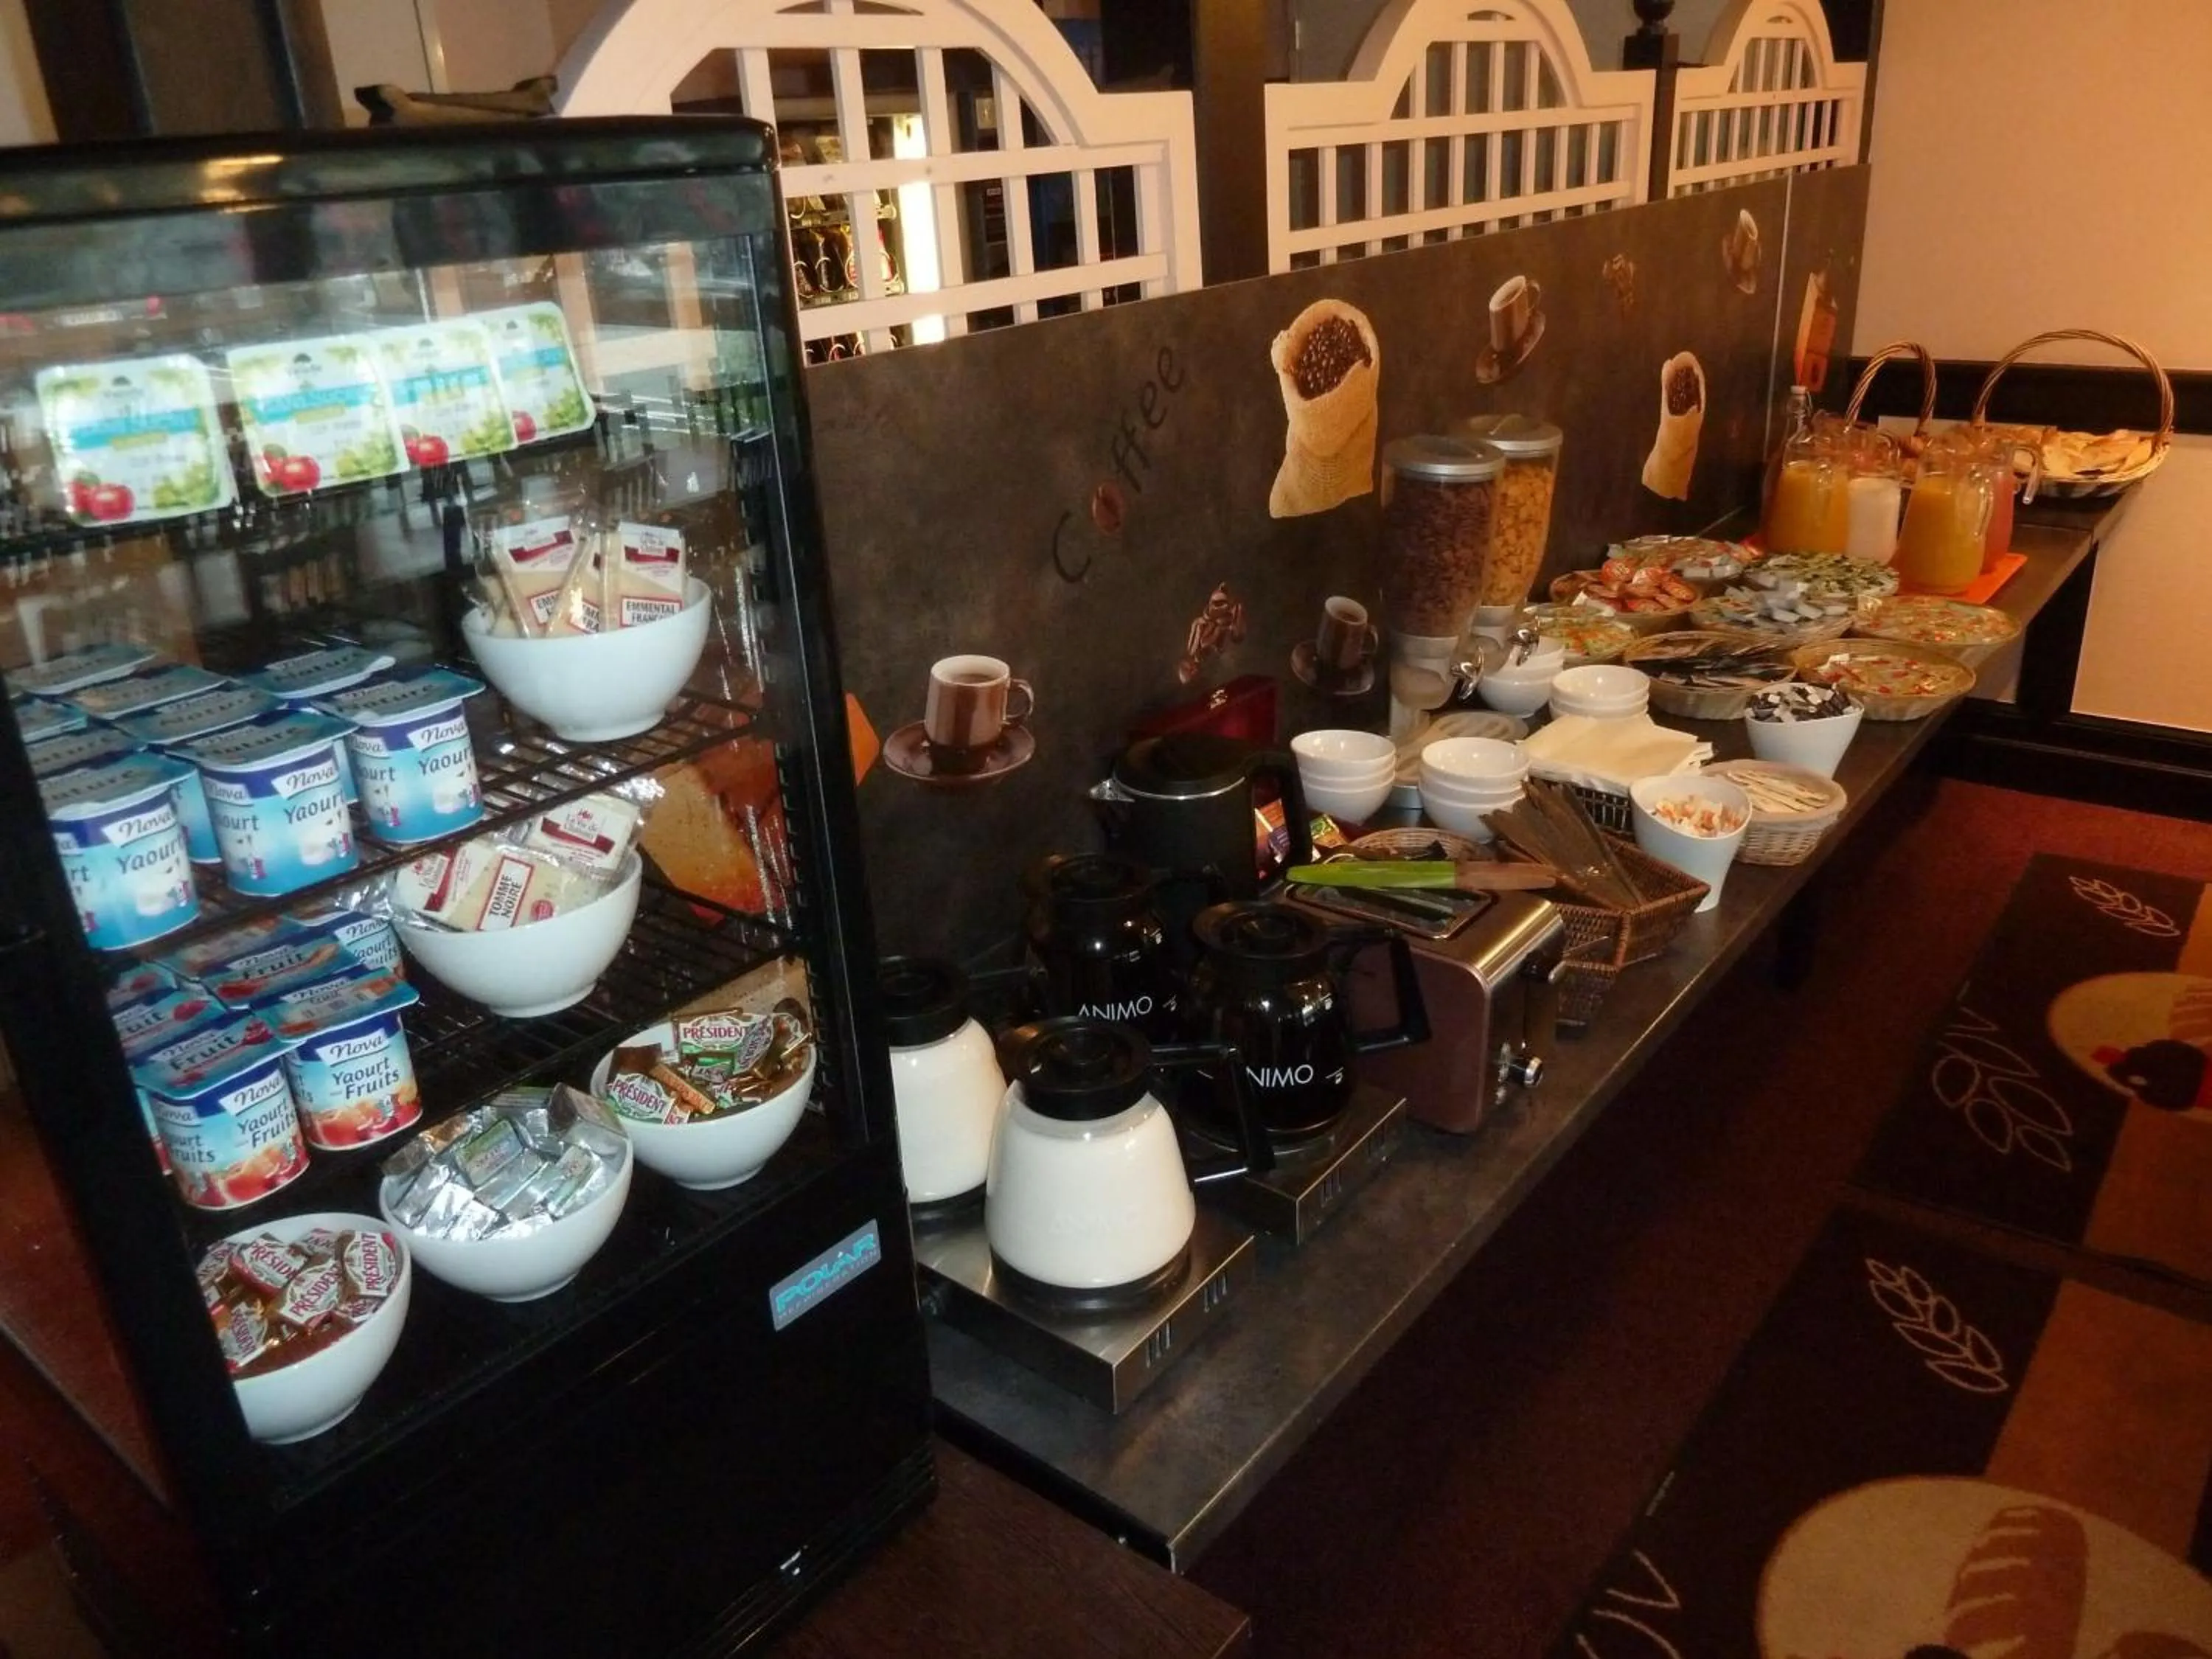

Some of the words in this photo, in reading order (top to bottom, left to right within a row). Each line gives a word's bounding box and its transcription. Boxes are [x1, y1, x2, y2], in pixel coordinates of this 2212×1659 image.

[421, 720, 466, 742] Nova
[286, 766, 335, 790] Nova
[119, 810, 172, 838] Nova
[489, 874, 512, 917] TOMME
[501, 881, 522, 918] NOIRE
[1078, 995, 1152, 1021] ANIMO
[170, 1034, 238, 1071] Fruit
[330, 1035, 384, 1059] Nova
[332, 1057, 390, 1086] Yaourt
[345, 1069, 400, 1100] Fruits
[1245, 1063, 1314, 1088] NIMO
[234, 1075, 282, 1107] Nova
[775, 1233, 876, 1316] POLAR
